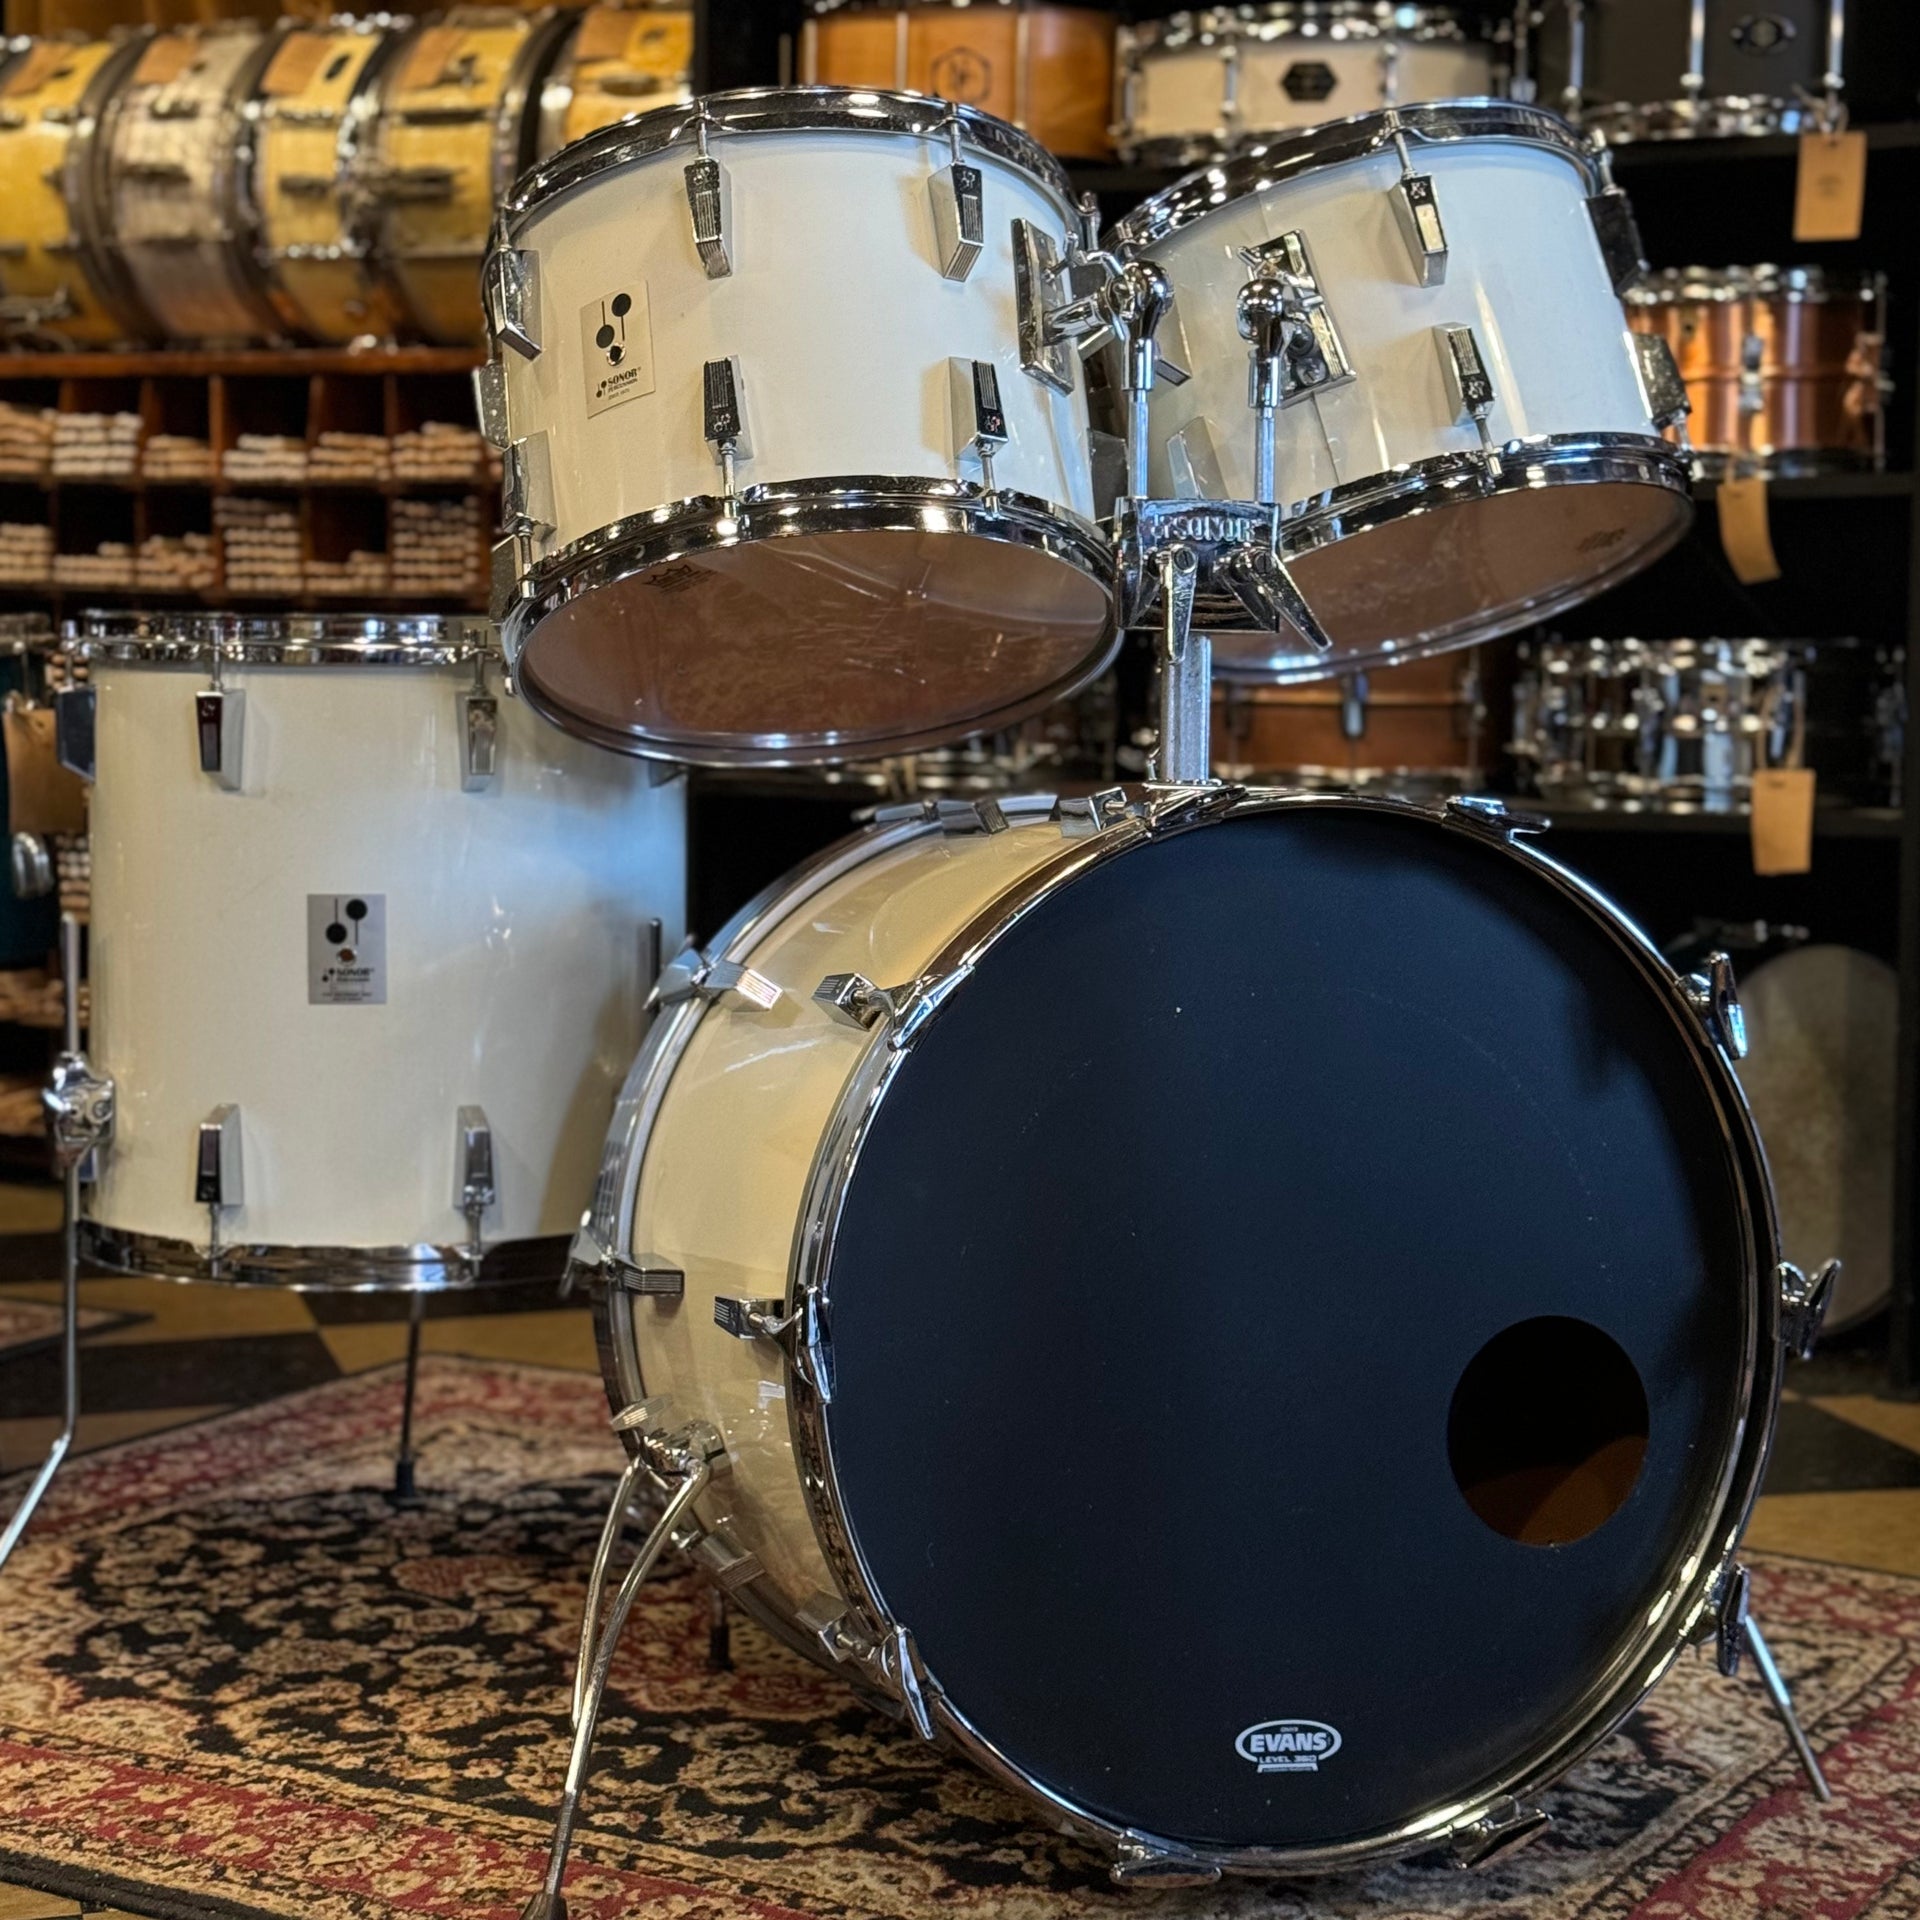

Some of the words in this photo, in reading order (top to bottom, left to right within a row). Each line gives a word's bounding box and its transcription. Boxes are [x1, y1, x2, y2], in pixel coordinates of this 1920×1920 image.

[608, 368, 638, 385] SONOR
[1173, 515, 1256, 543] SONOR
[1250, 1732, 1328, 1753] EVANS
[1259, 1755, 1291, 1764] LEVEL
